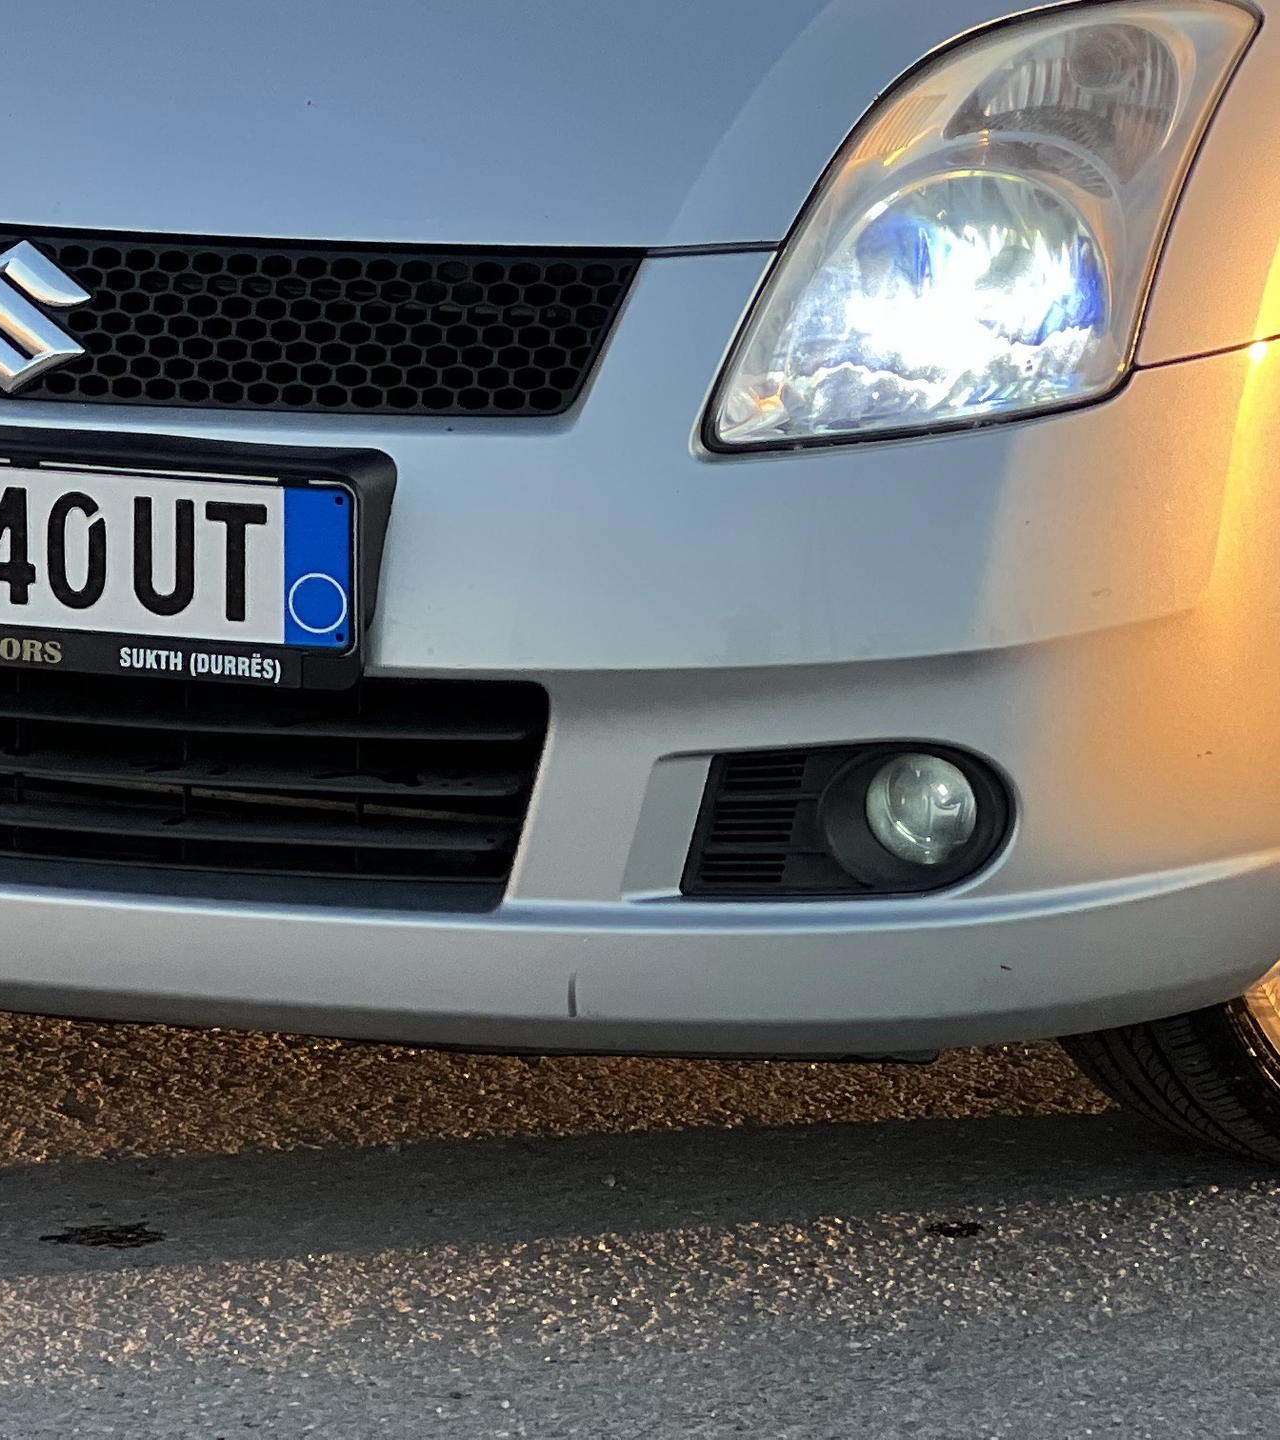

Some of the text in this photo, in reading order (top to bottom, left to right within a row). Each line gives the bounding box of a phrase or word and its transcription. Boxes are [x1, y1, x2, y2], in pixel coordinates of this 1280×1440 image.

[133, 496, 268, 622] UT
[120, 646, 282, 684] SUKTH (DURRËS)
